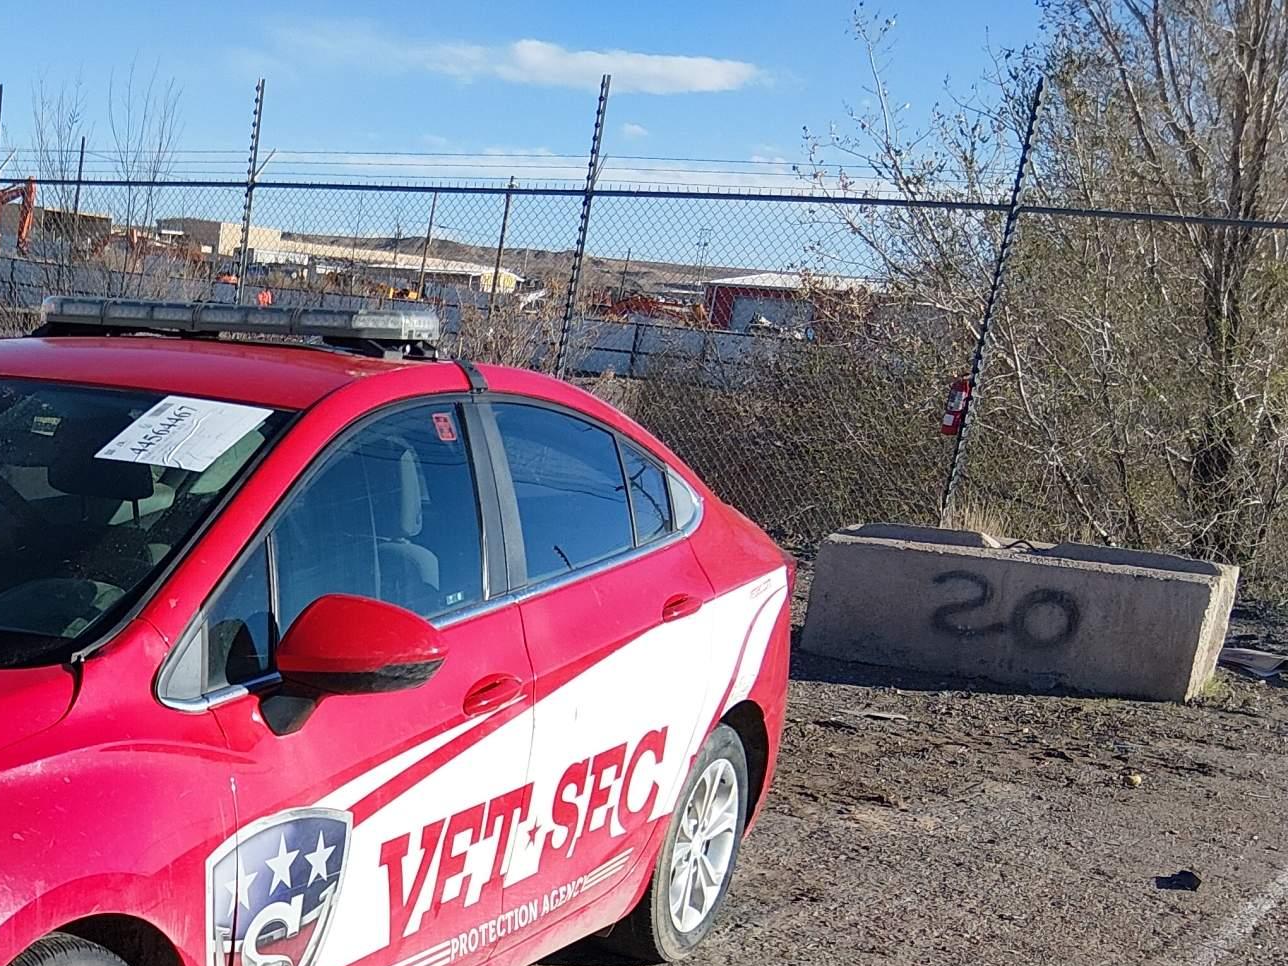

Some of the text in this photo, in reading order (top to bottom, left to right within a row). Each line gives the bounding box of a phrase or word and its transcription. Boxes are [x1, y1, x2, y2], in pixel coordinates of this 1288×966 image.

[129, 405, 197, 457] 44564467
[932, 569, 1080, 650] 20
[379, 726, 669, 939] VET SEC
[450, 875, 589, 961] PROTECTION AGENCY
